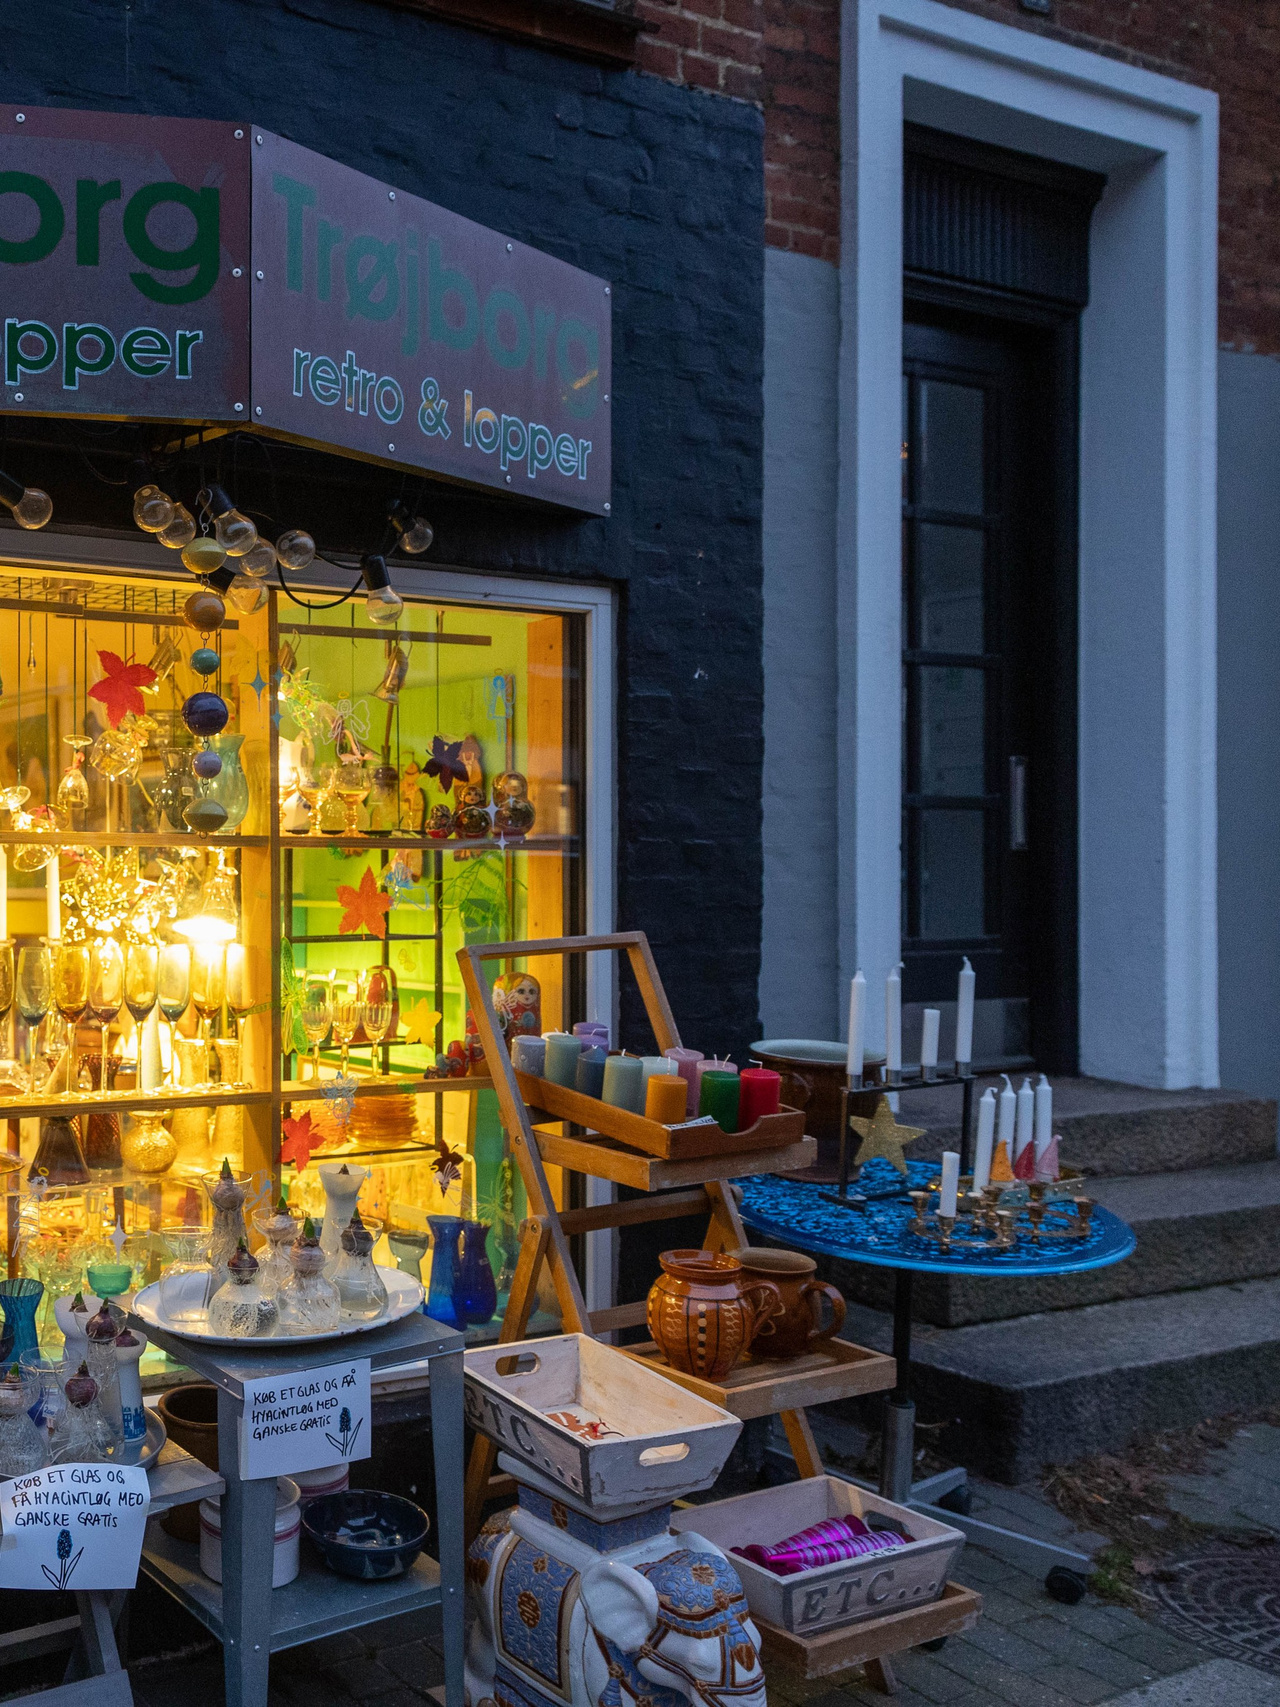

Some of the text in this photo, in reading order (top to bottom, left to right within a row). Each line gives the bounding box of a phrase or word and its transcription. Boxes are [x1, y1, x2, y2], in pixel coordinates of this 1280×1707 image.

[272, 172, 600, 420] Trøjborg
[292, 347, 592, 480] retro & lopper
[253, 1392, 277, 1406] KØB
[280, 1387, 295, 1400] ET
[297, 1383, 321, 1397] GLAS
[324, 1378, 338, 1393] OG
[316, 1397, 339, 1412] MED
[253, 1423, 298, 1441] GANSKE
[14, 1469, 126, 1491] KØB ET GLAS OG
[11, 1491, 32, 1508] FÅ
[118, 1492, 144, 1507] MED
[15, 1512, 70, 1527] GANSKE
[798, 1568, 937, 1626] ETC...
